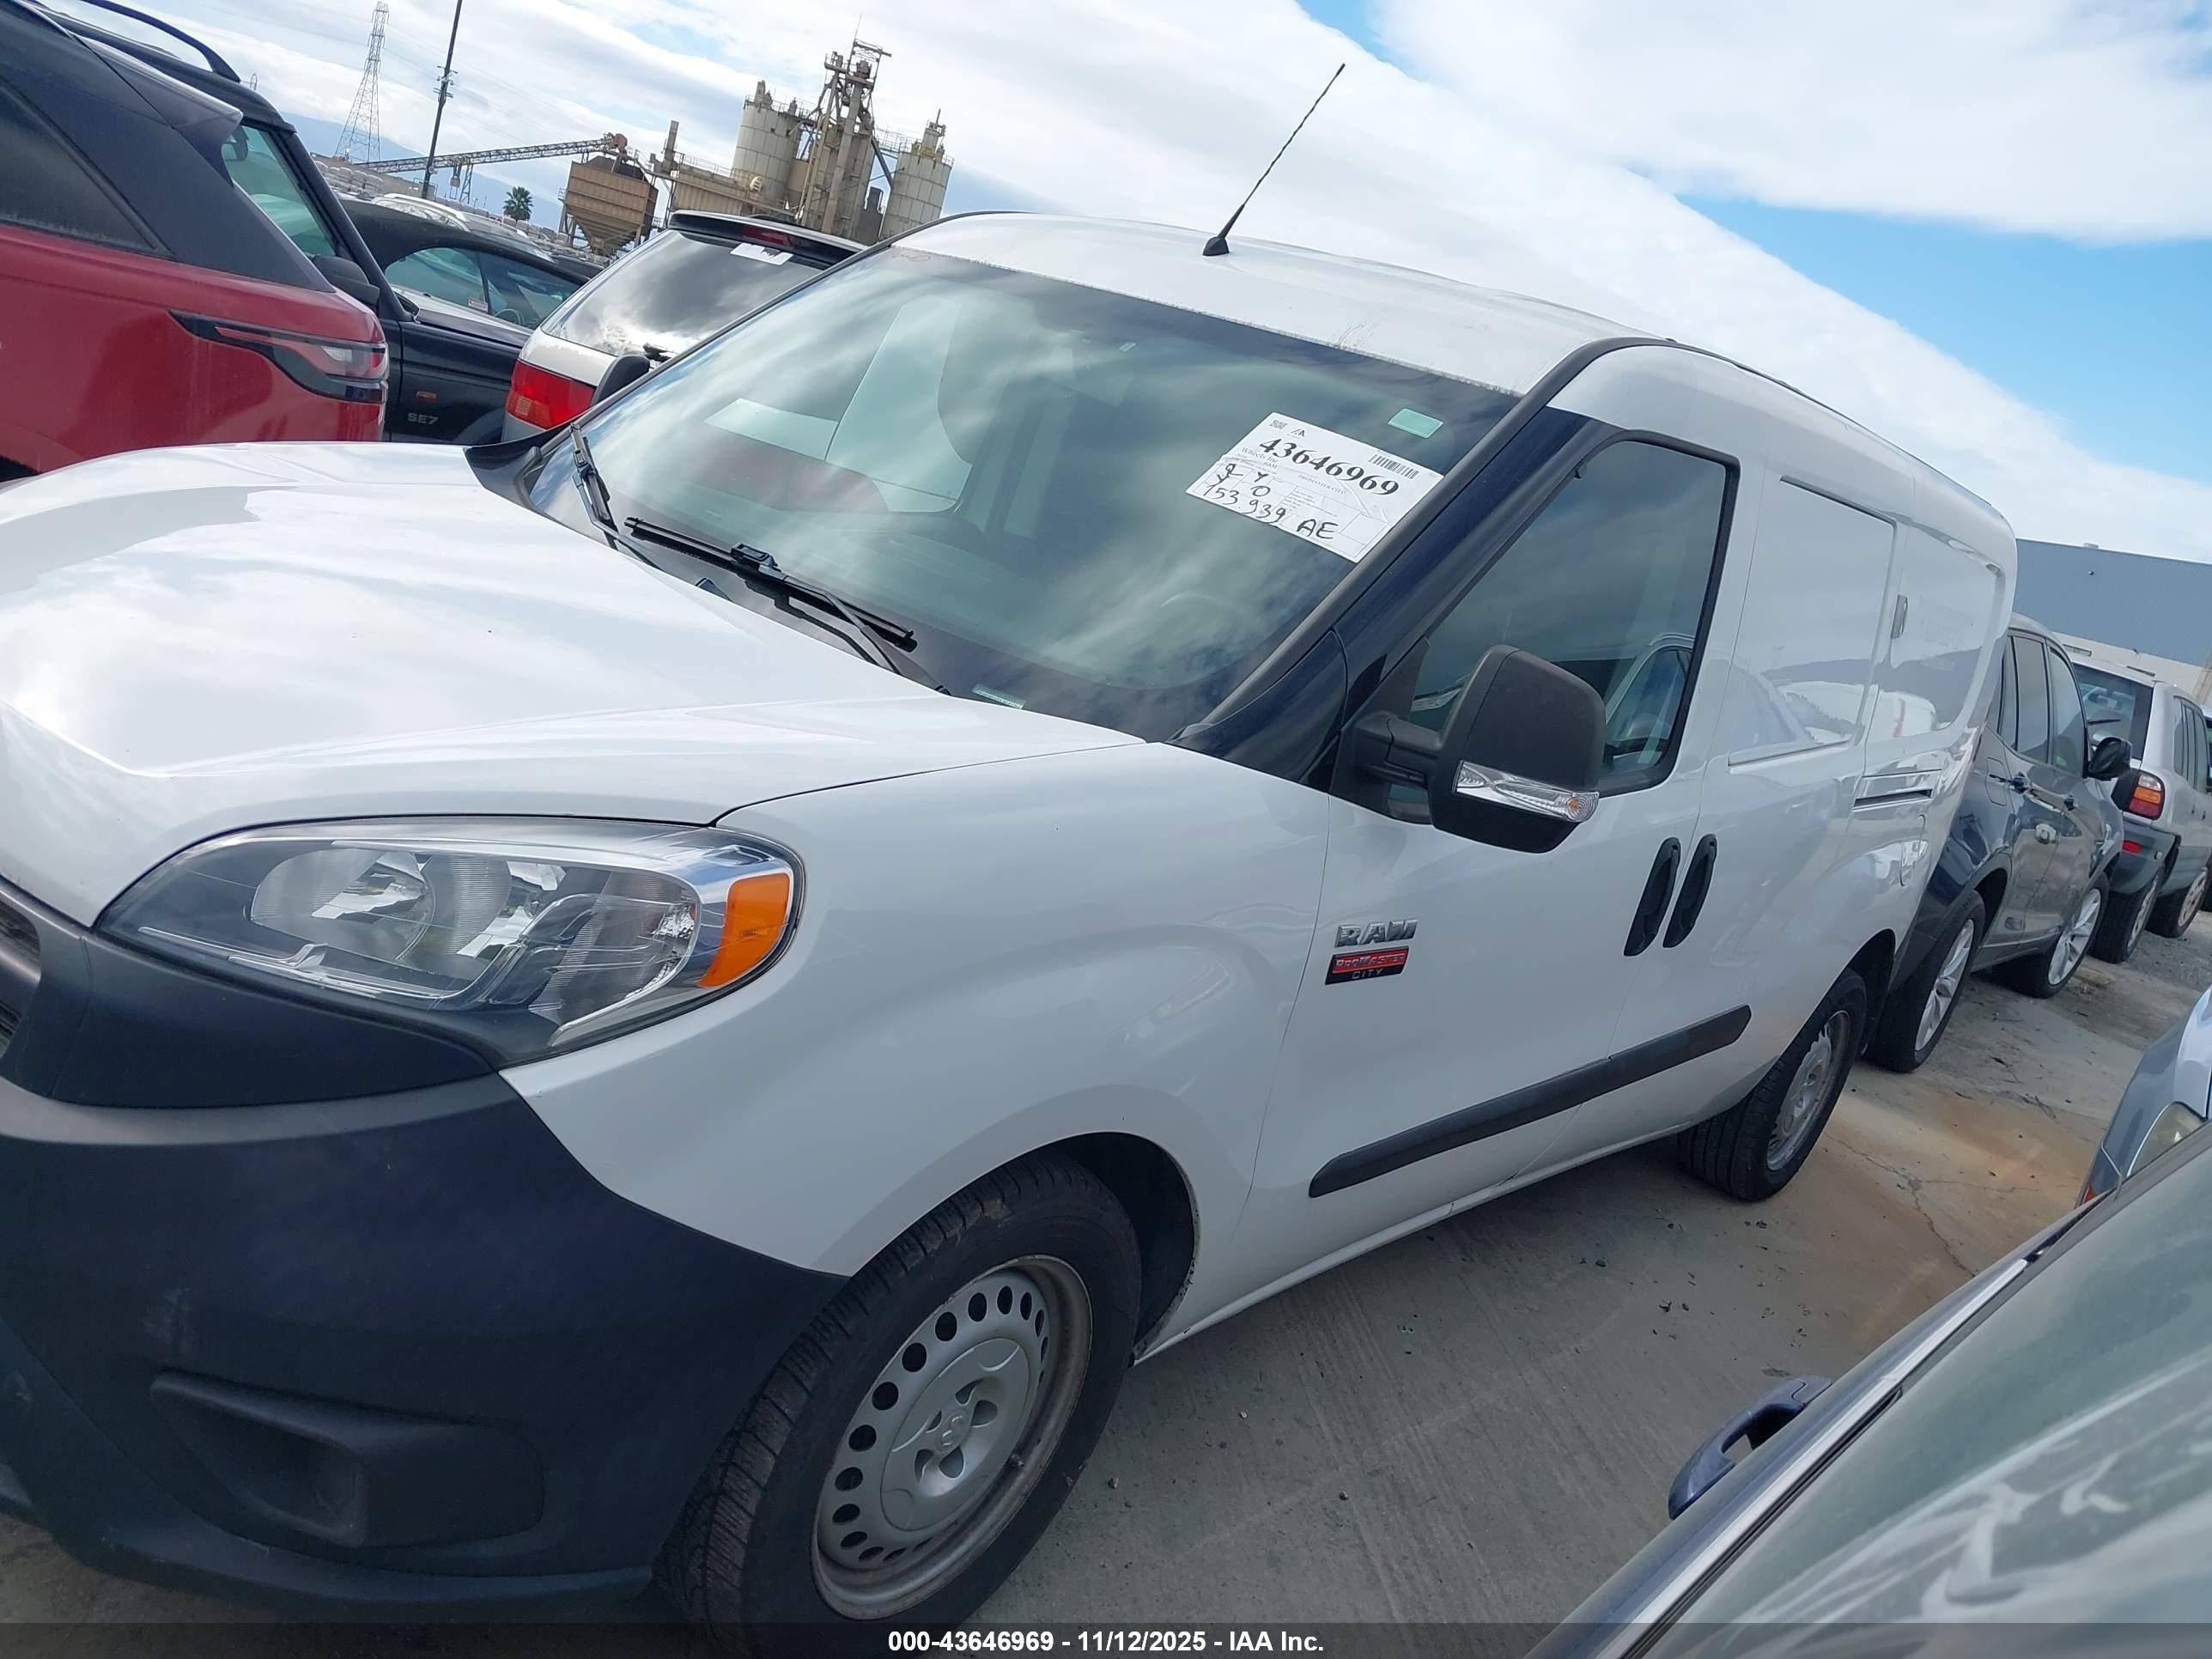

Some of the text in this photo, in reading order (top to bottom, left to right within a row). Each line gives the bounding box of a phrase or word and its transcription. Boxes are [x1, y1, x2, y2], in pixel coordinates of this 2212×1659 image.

[407, 412, 440, 425] SE7
[1259, 438, 1400, 495] 43646969
[1334, 918, 1419, 947] RAM
[1352, 968, 1383, 980] CITY
